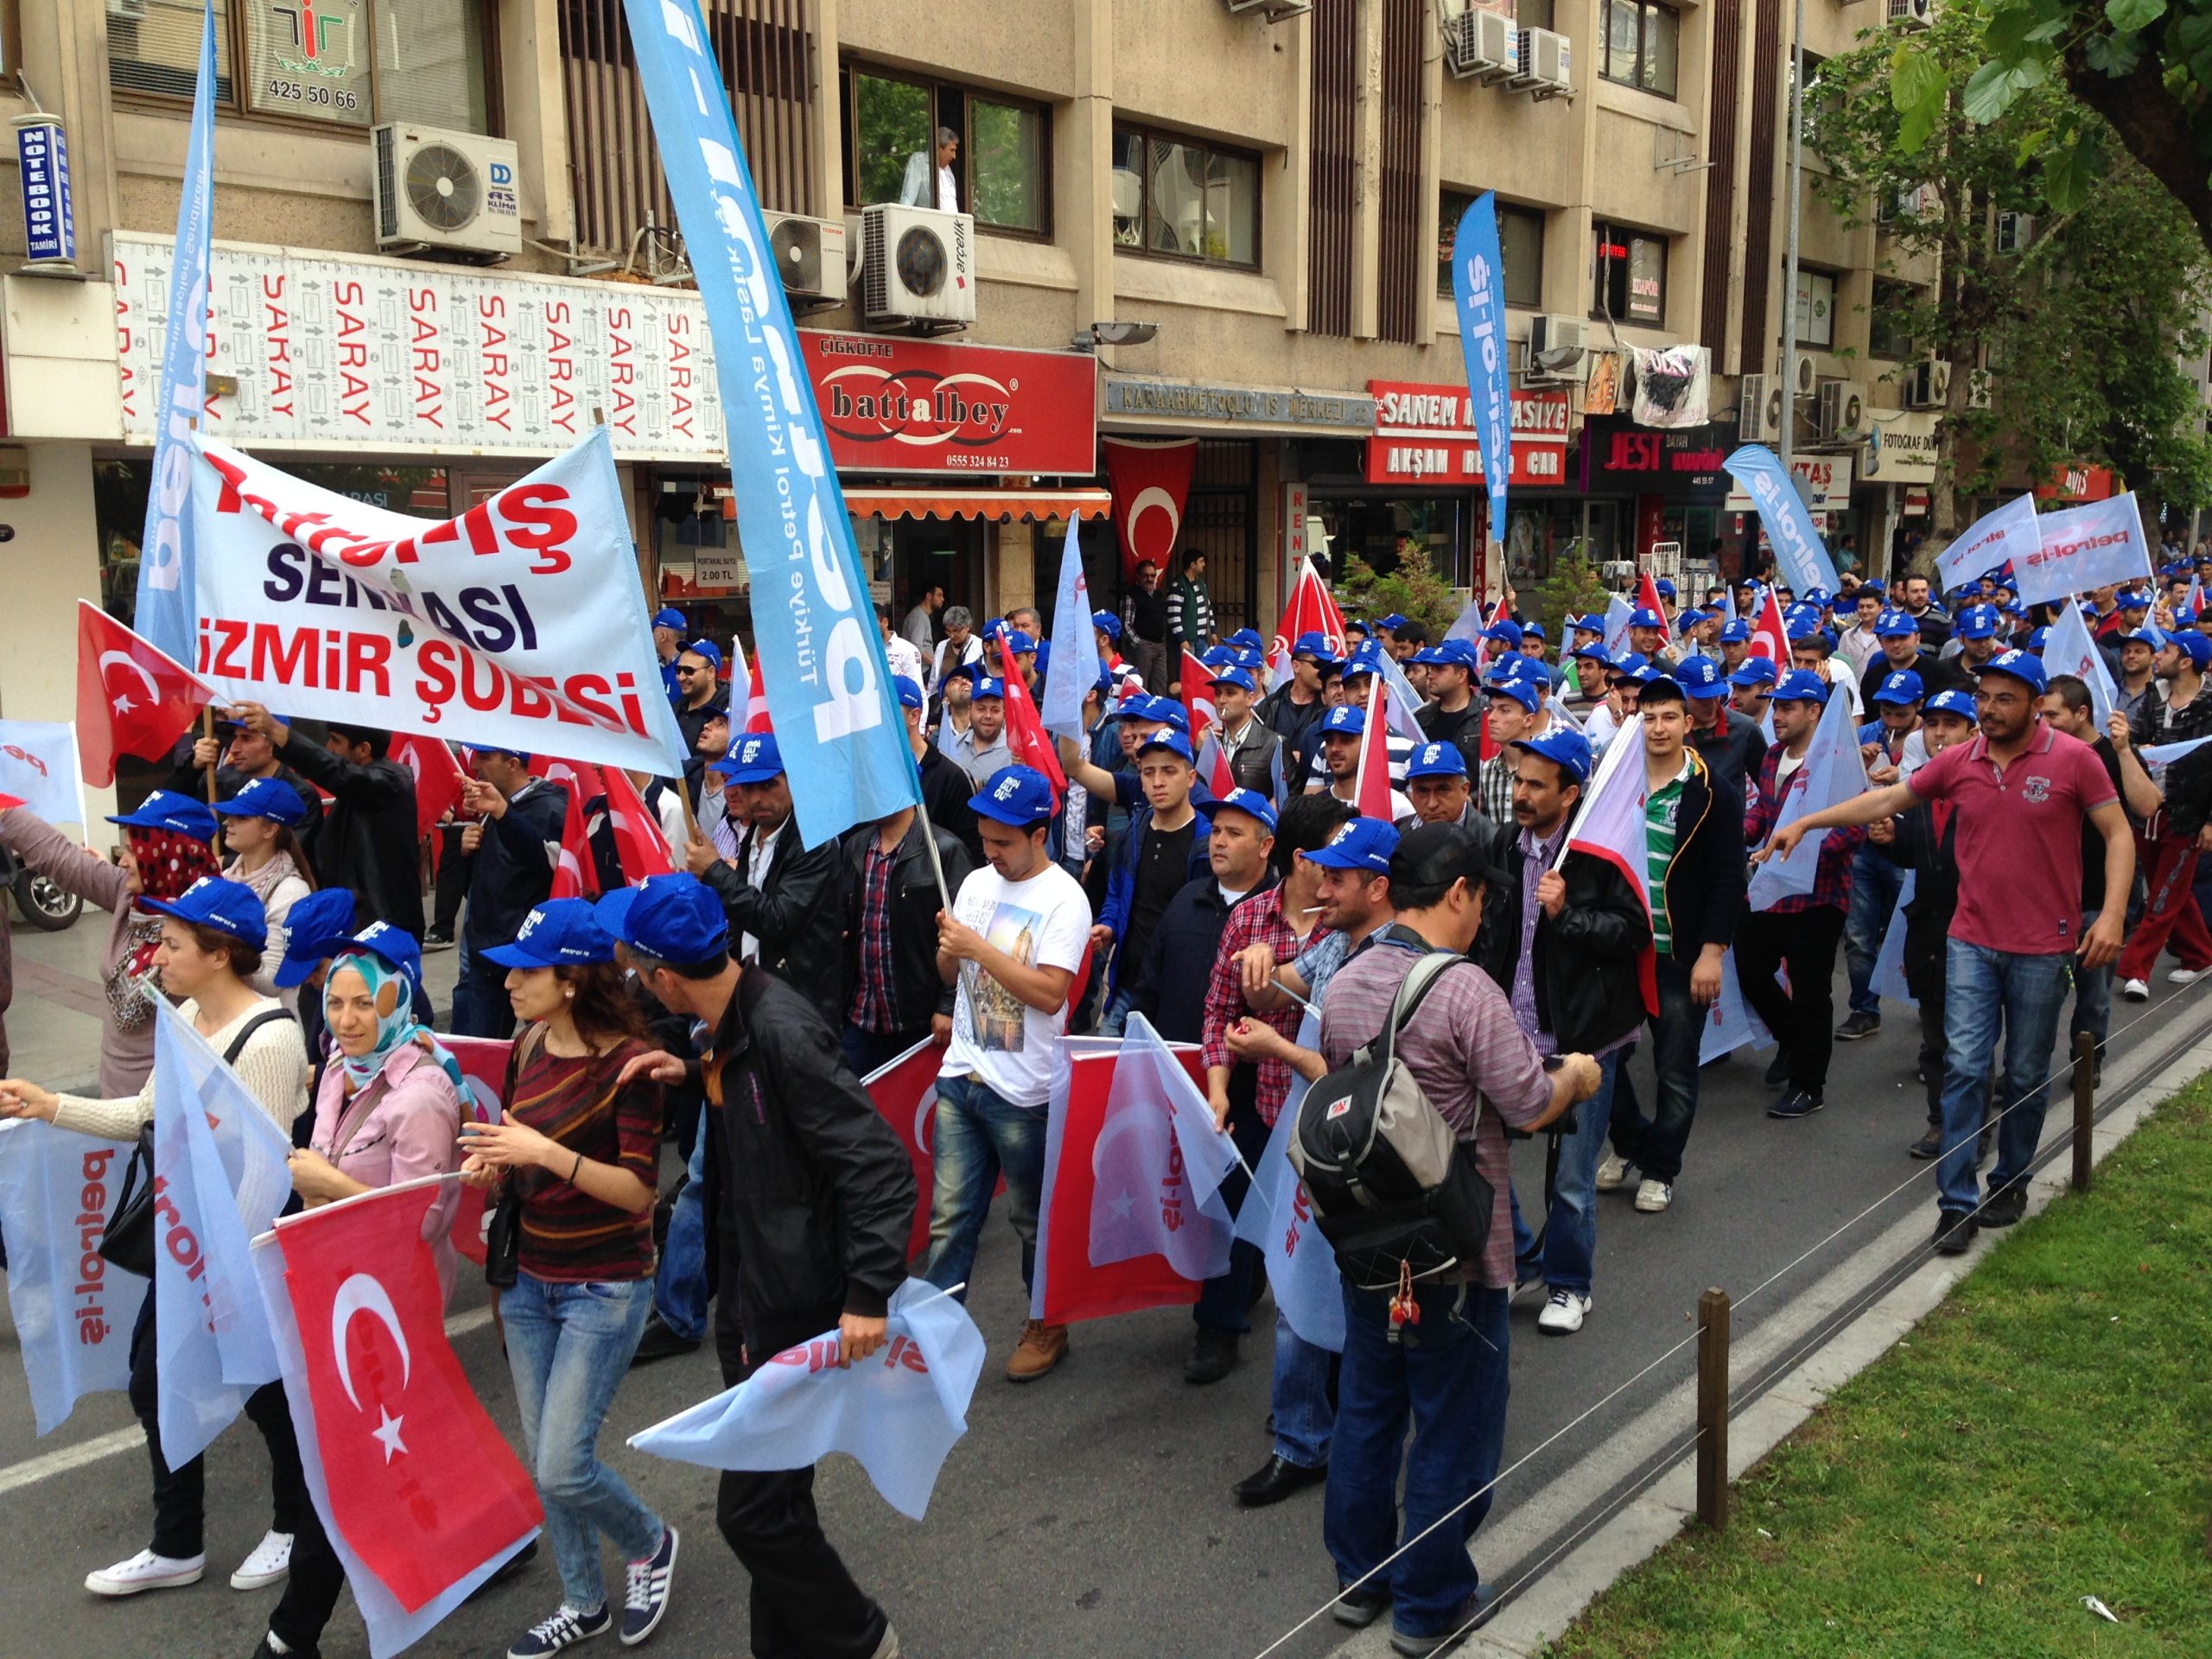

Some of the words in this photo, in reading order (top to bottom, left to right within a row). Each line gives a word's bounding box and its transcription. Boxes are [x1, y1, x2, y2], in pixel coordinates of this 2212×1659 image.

[269, 79, 302, 100] 425
[308, 86, 329, 105] 50
[334, 90, 356, 110] 66
[24, 130, 53, 235] NOTEBOOK
[488, 200, 516, 210] KLİMA
[30, 238, 57, 251] TAMİRİ
[823, 227, 842, 236] TOSHIBA
[953, 217, 965, 274] arçelik
[334, 281, 371, 426] SARAY
[410, 288, 443, 429] SARAY
[480, 295, 512, 432] SARAY
[819, 337, 893, 359] ÇİĞKÖFTE
[546, 301, 575, 435] SARAY
[608, 308, 636, 437] SARAY
[668, 313, 694, 440] SARAY
[830, 385, 1009, 434] battalbey
[1382, 391, 1459, 426] SANEM
[1604, 432, 1664, 470] JEST
[1666, 435, 1688, 448] BAYAN
[946, 454, 967, 467] 0555
[969, 455, 985, 467] 324
[987, 456, 997, 467] 84
[999, 456, 1009, 468] 23
[1387, 447, 1449, 479] AKŞAM
[1527, 451, 1558, 475] CAR
[1293, 492, 1302, 572] RENT
[697, 557, 722, 566] PORTAKAL
[702, 571, 720, 581] 2.00
[722, 570, 733, 580] TL
[198, 617, 391, 697] İZMİR
